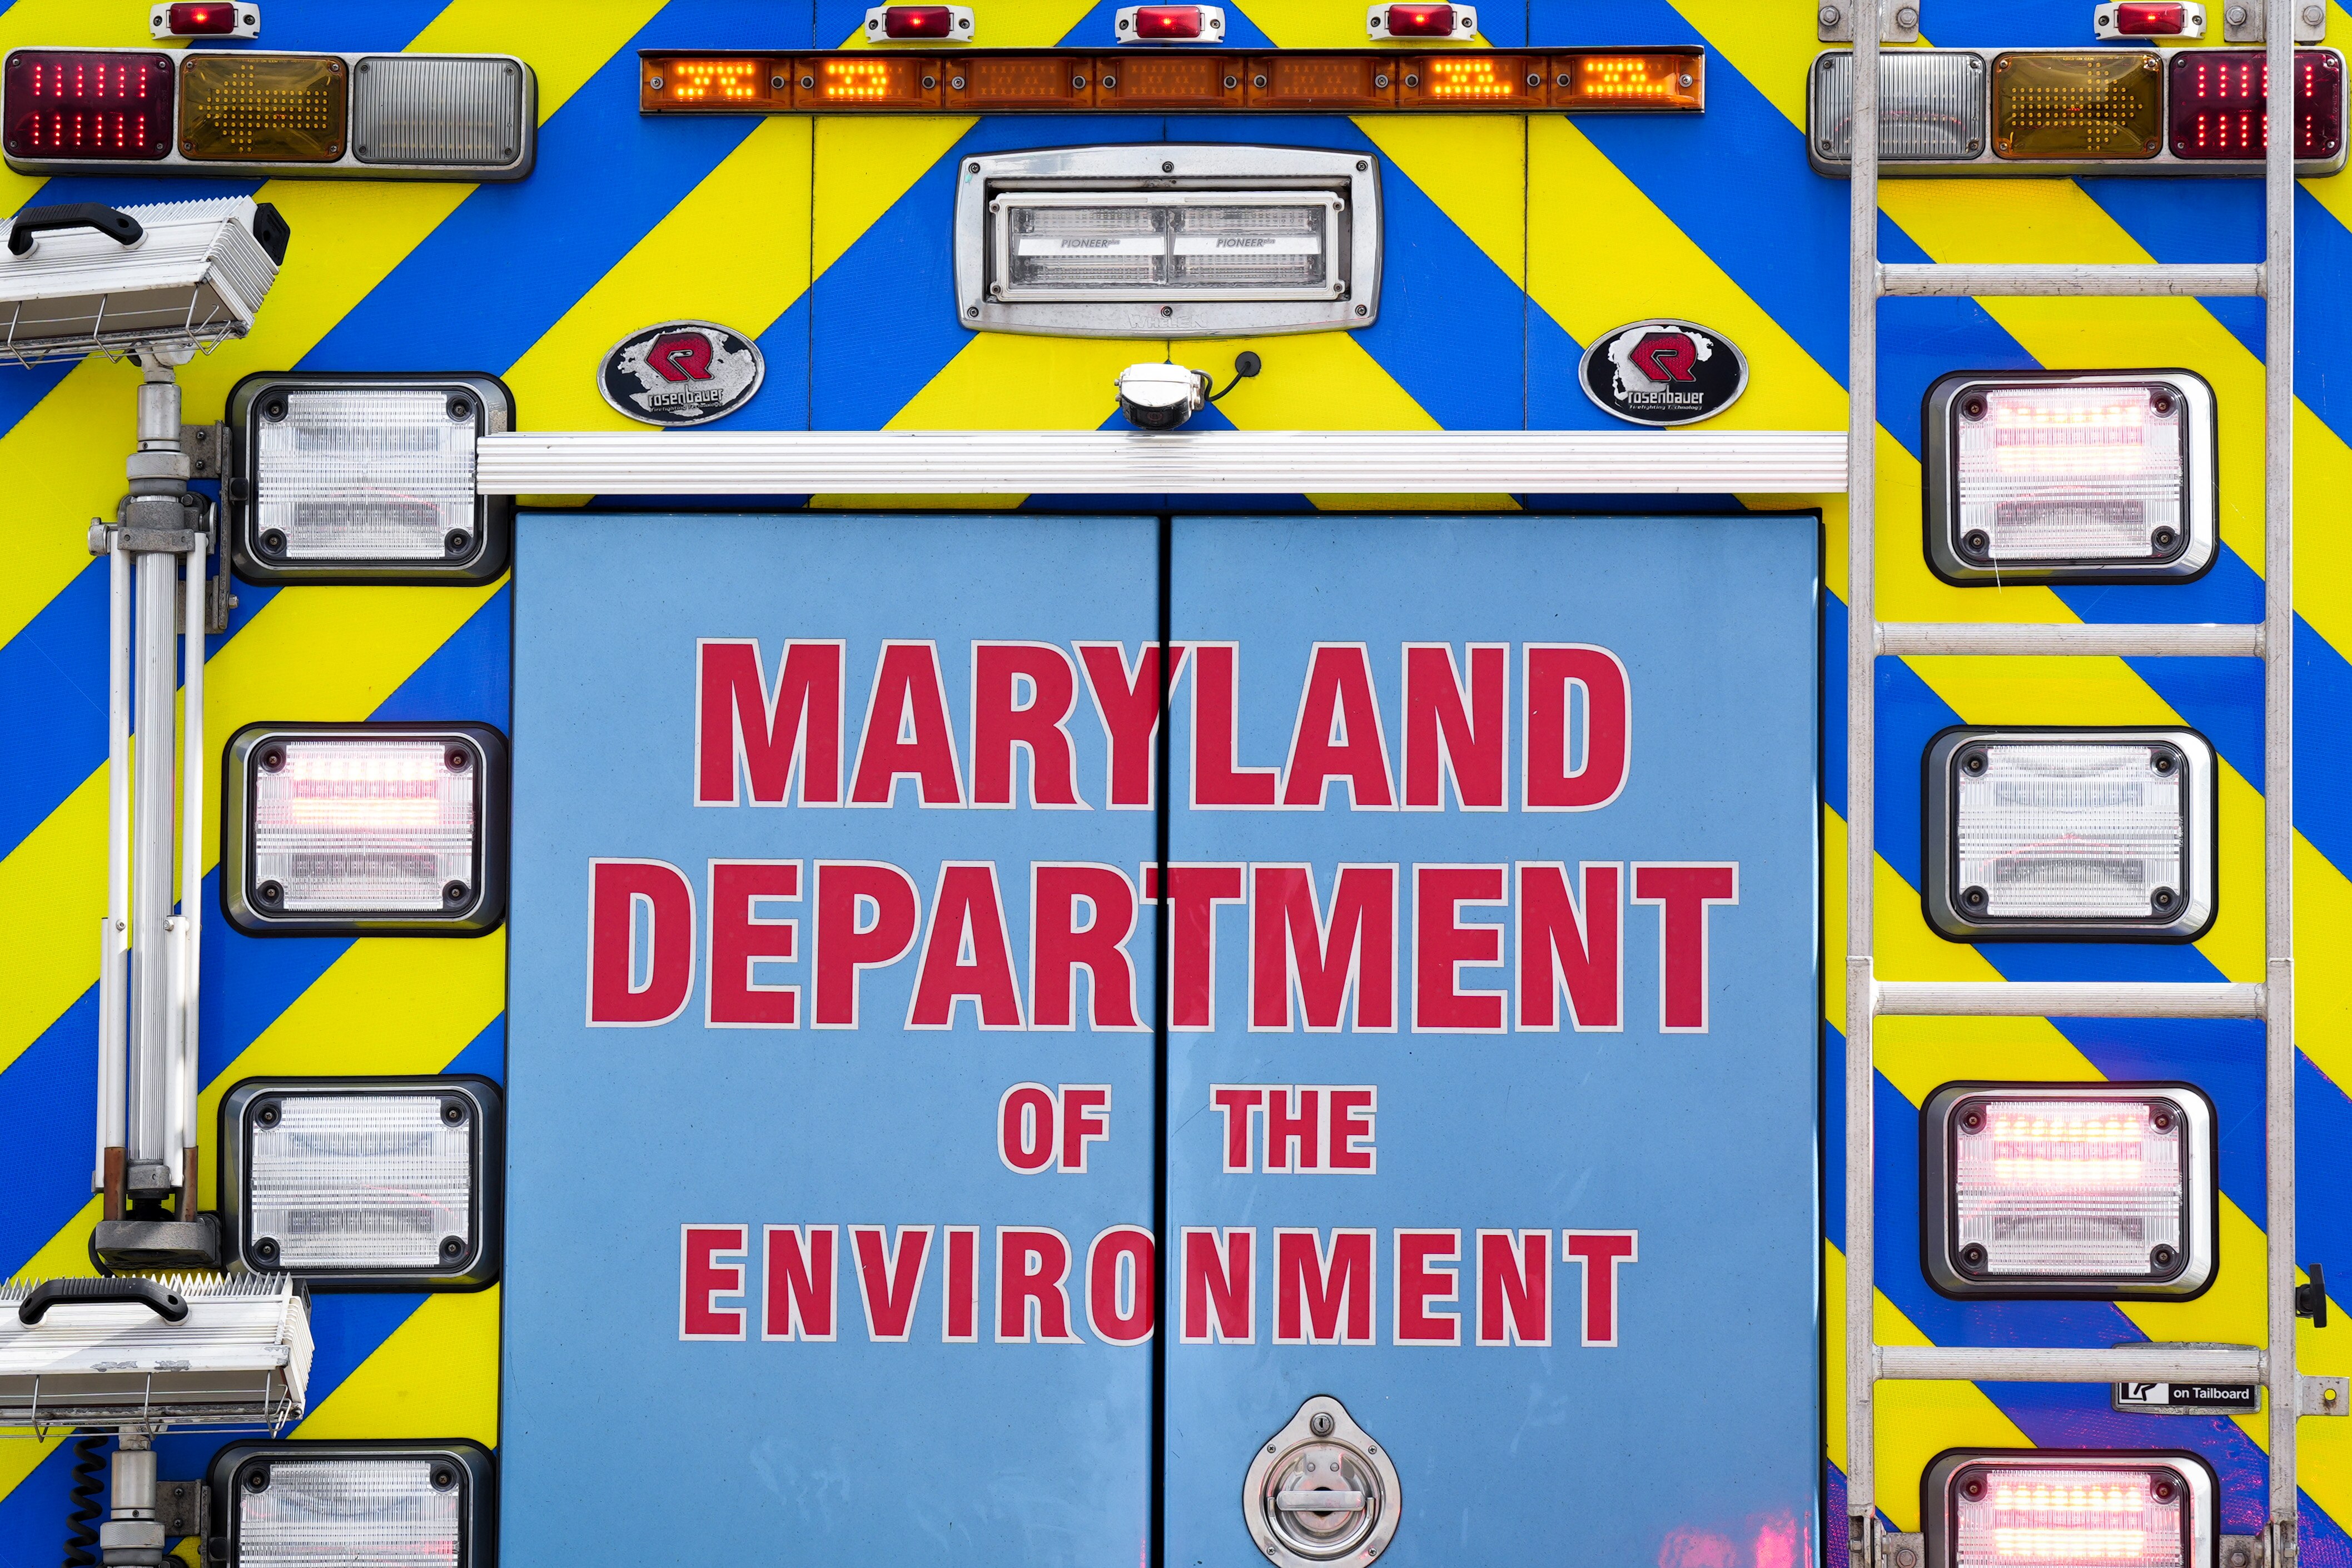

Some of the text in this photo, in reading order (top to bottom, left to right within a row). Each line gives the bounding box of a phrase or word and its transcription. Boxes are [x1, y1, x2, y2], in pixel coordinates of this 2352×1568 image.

[1127, 313, 1207, 328] WHELEN
[648, 385, 724, 407] rosenbauer
[1628, 385, 1704, 404] rosenbauer
[694, 638, 1632, 812] MARYLAND
[586, 858, 1739, 1034] DEPARTMENT
[998, 1082, 1378, 1174] OF THE
[679, 1224, 1638, 1347] ENVIRONMENT
[2174, 1387, 2249, 1400] on Tailboard
